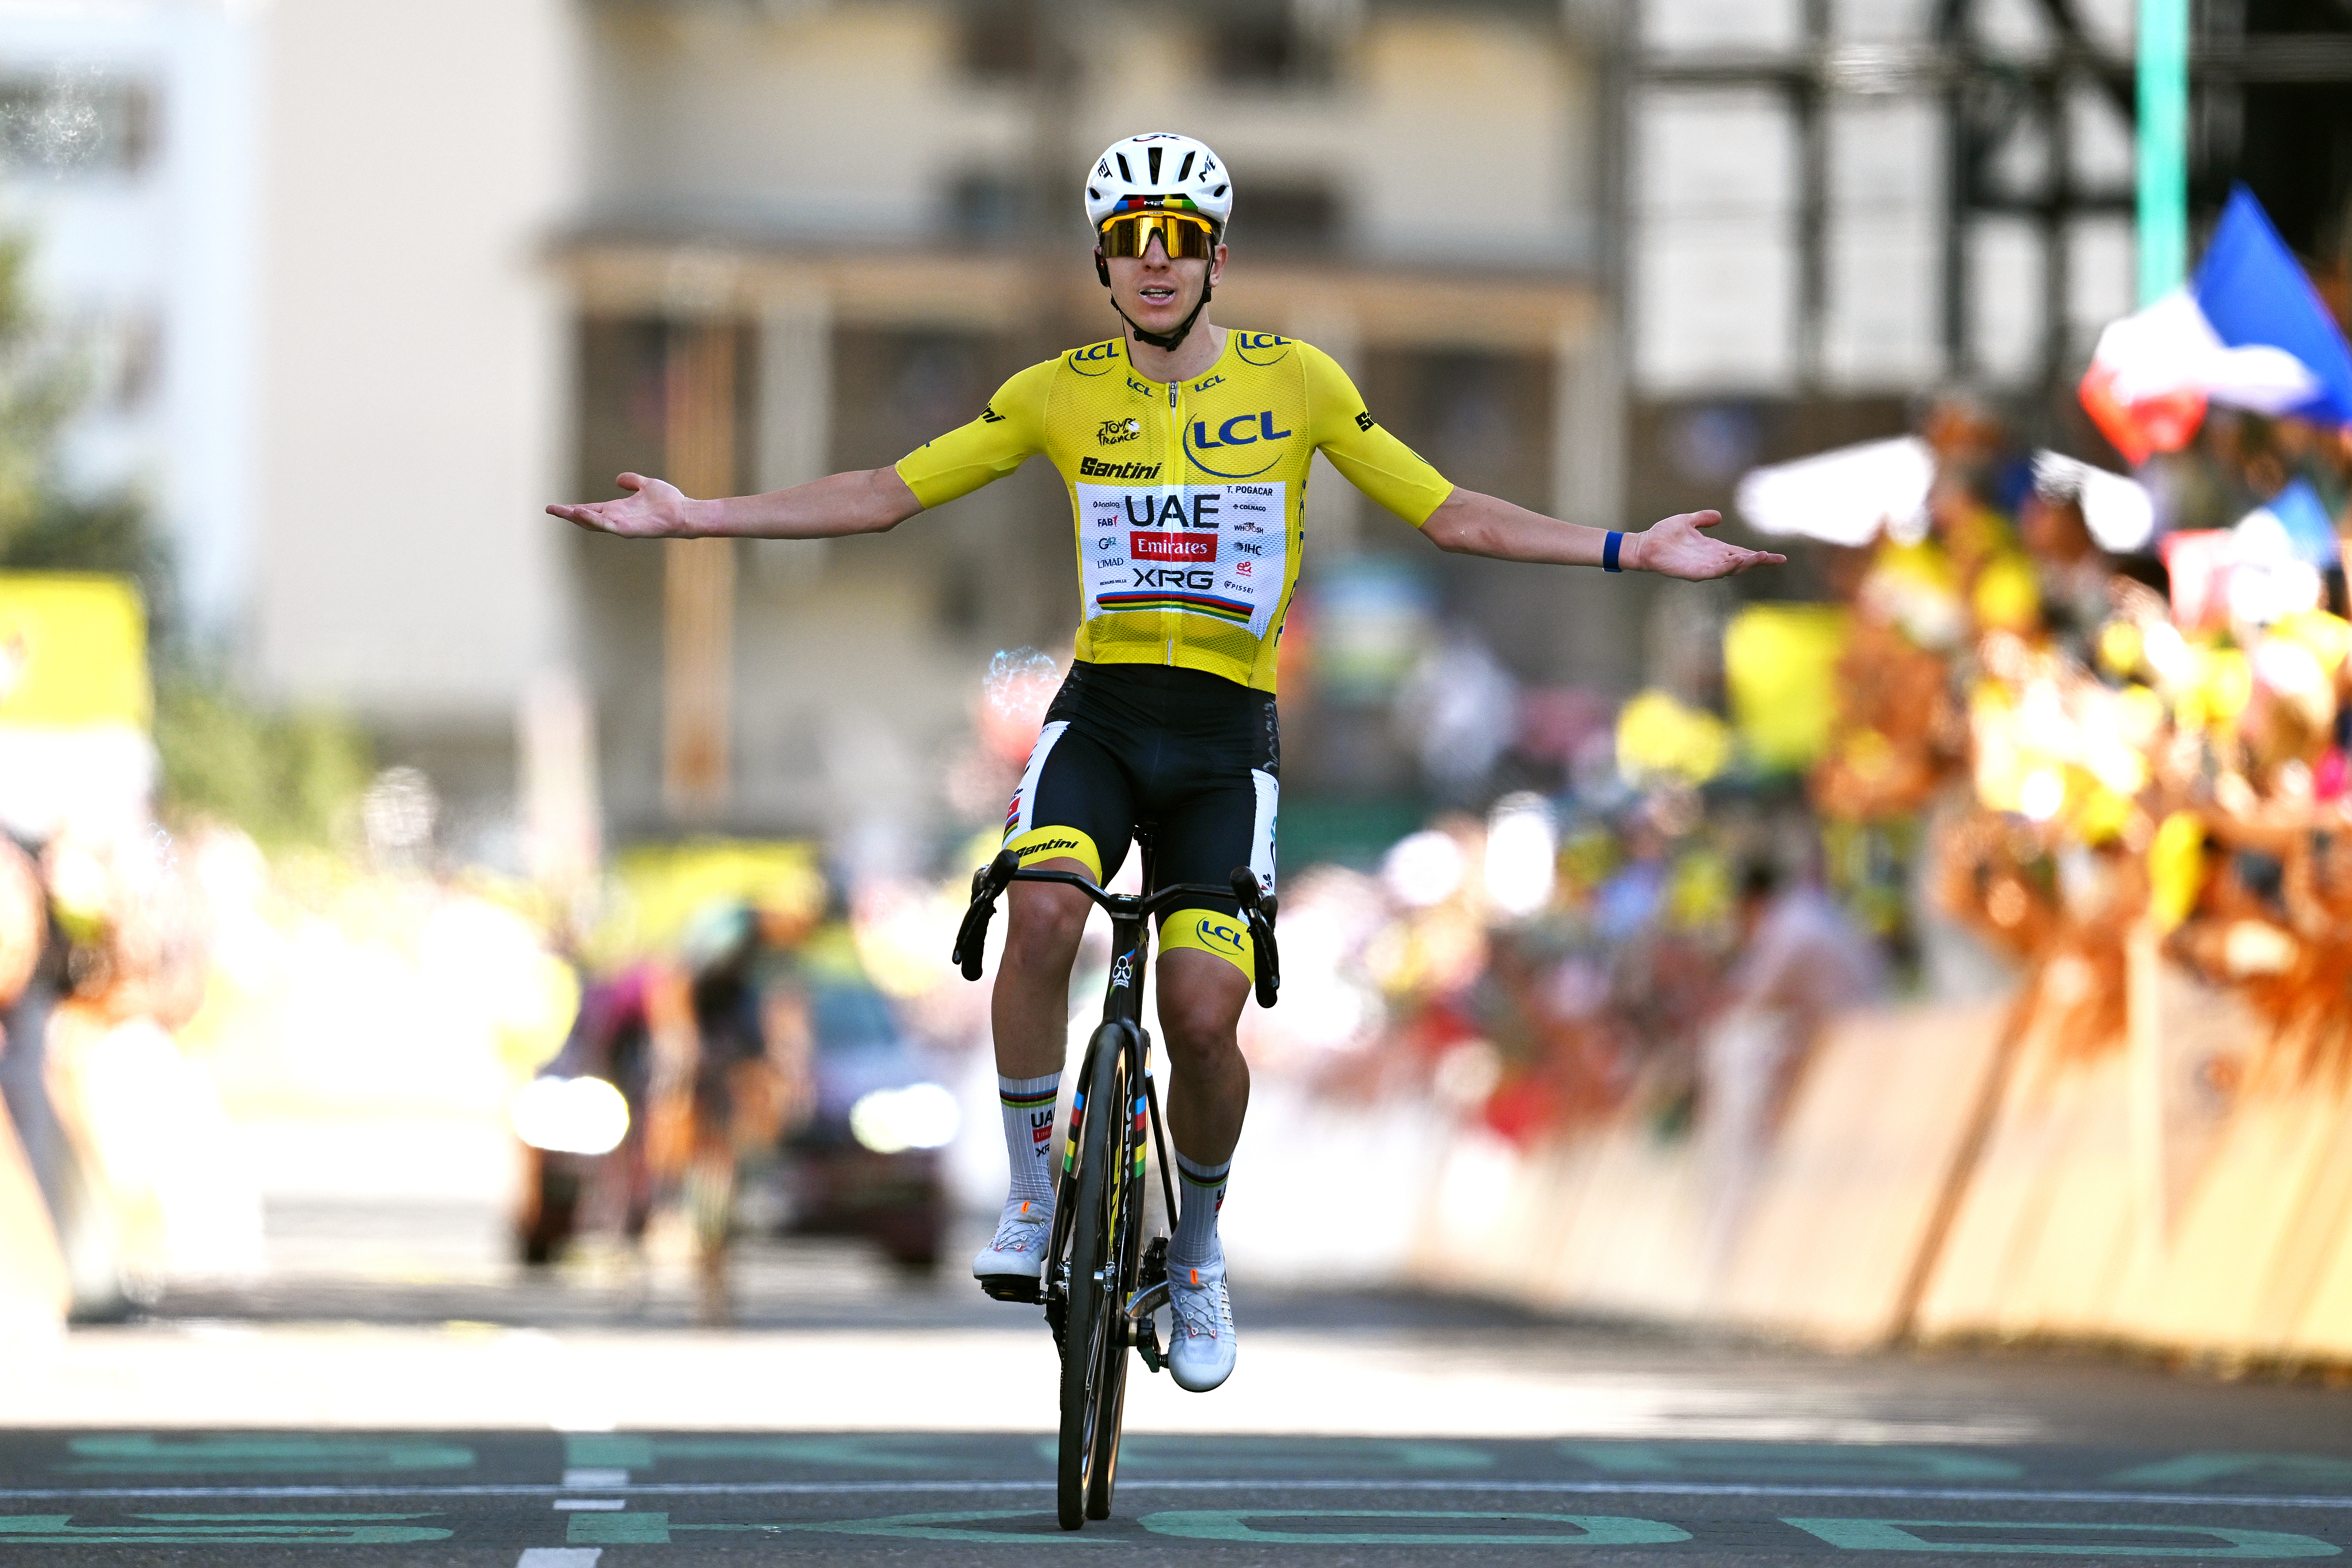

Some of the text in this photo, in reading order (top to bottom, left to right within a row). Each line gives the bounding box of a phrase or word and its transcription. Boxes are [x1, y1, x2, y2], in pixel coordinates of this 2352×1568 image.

[1240, 333, 1291, 349] LCL
[1075, 342, 1119, 361] LCL
[1127, 377, 1153, 397] LCL
[1195, 376, 1226, 392] LCL
[1194, 411, 1291, 449] LCL
[1080, 456, 1163, 479] Santini
[1236, 486, 1273, 496] POGACAR
[1125, 495, 1220, 528] UAE
[1138, 538, 1207, 554] Emirates
[1244, 544, 1262, 555] IHC
[1133, 568, 1213, 589] XRG
[1232, 584, 1253, 594] PISSEI
[1202, 921, 1244, 951] LCL
